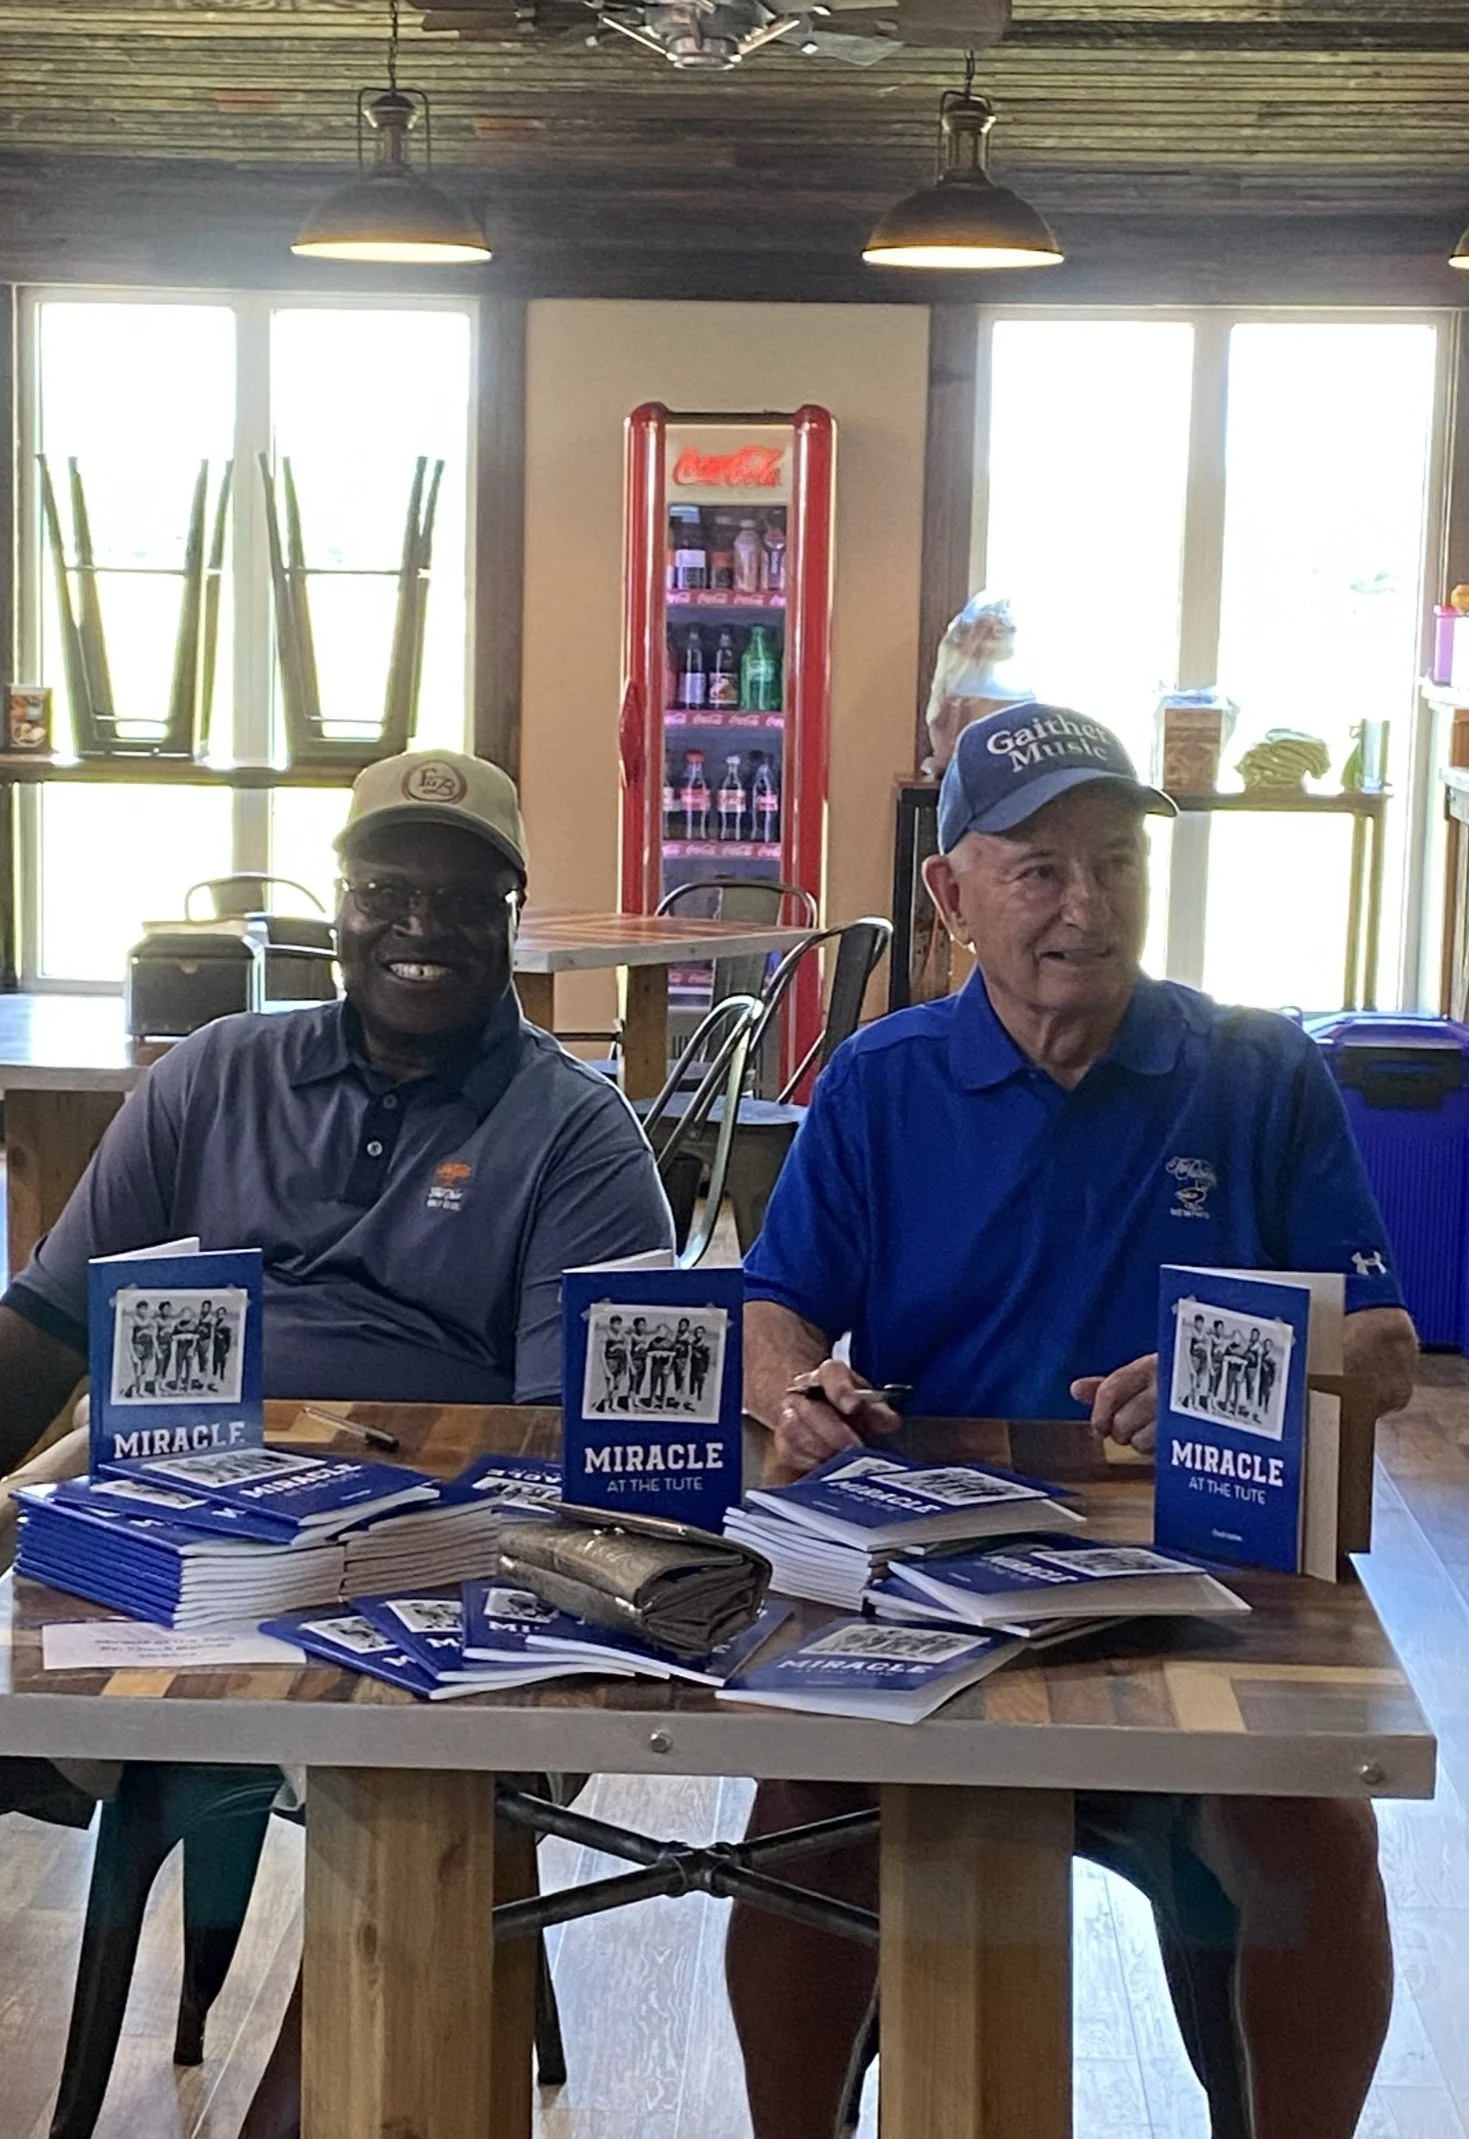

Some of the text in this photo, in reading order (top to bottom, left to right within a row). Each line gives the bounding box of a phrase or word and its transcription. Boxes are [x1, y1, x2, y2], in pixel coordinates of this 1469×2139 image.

[987, 714, 1110, 755] Gaither
[1010, 738, 1107, 773] Music
[113, 1421, 245, 1459] MIRACLE
[584, 1443, 724, 1474] MIRACLE
[1171, 1439, 1285, 1487] MIRACLE
[239, 1463, 362, 1499] MIRACLE
[607, 1476, 703, 1493] AT THE TUTE
[828, 1481, 942, 1514] MIRACLE
[1189, 1476, 1266, 1505] AT THE TUTE
[776, 1658, 934, 1674] MIRACLE
